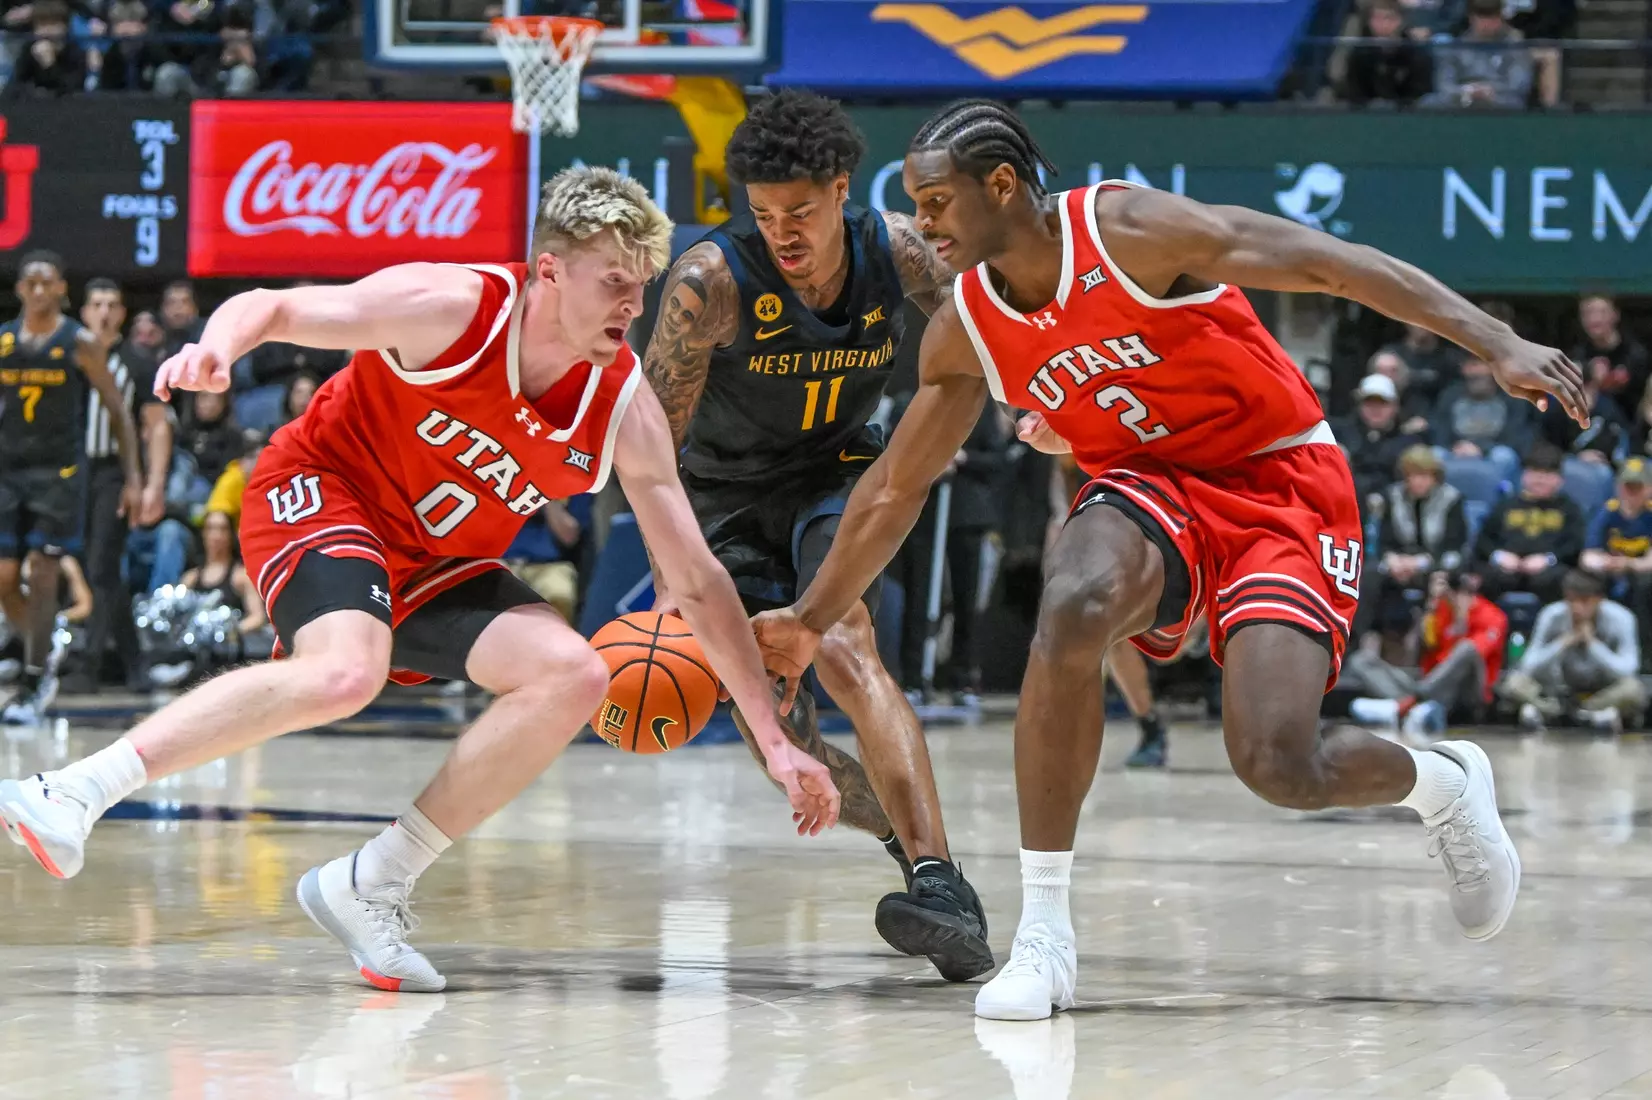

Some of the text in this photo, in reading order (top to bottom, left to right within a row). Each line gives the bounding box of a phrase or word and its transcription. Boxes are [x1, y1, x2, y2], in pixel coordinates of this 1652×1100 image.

[140, 140, 165, 190] 3
[223, 140, 497, 238] Coca-Cola
[135, 216, 160, 266] 9
[759, 304, 778, 316] 44
[748, 337, 894, 374] WEST VIRGINIA
[1026, 332, 1165, 411] UTAH
[18, 385, 43, 423] 7
[801, 375, 846, 430] 11
[1094, 383, 1172, 445] 2
[416, 408, 550, 516] UTAH
[413, 480, 479, 538] 0
